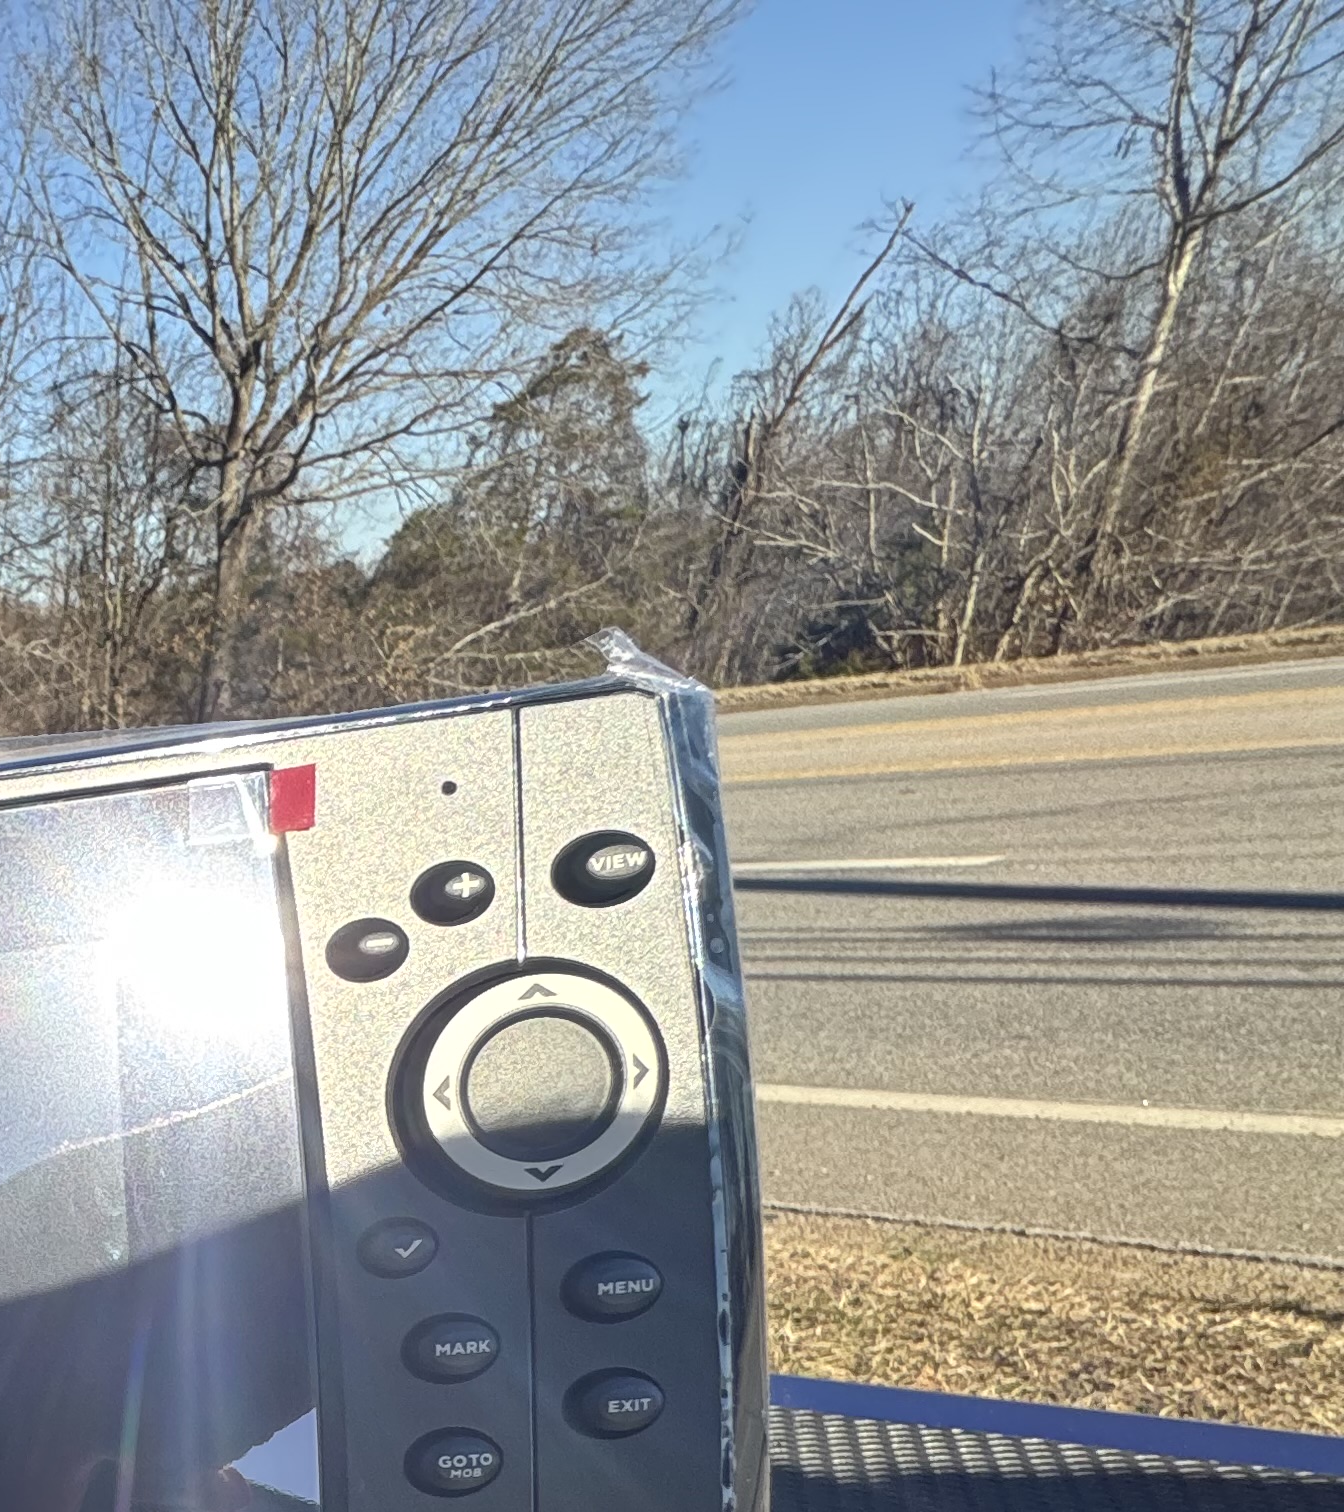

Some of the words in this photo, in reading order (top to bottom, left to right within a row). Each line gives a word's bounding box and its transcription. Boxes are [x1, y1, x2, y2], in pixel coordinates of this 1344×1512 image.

[590, 850, 648, 873] VIEW
[597, 1278, 654, 1296] MENU
[435, 1339, 491, 1357] MARK
[606, 1397, 652, 1414] EXIT
[449, 1468, 482, 1478] MOB
